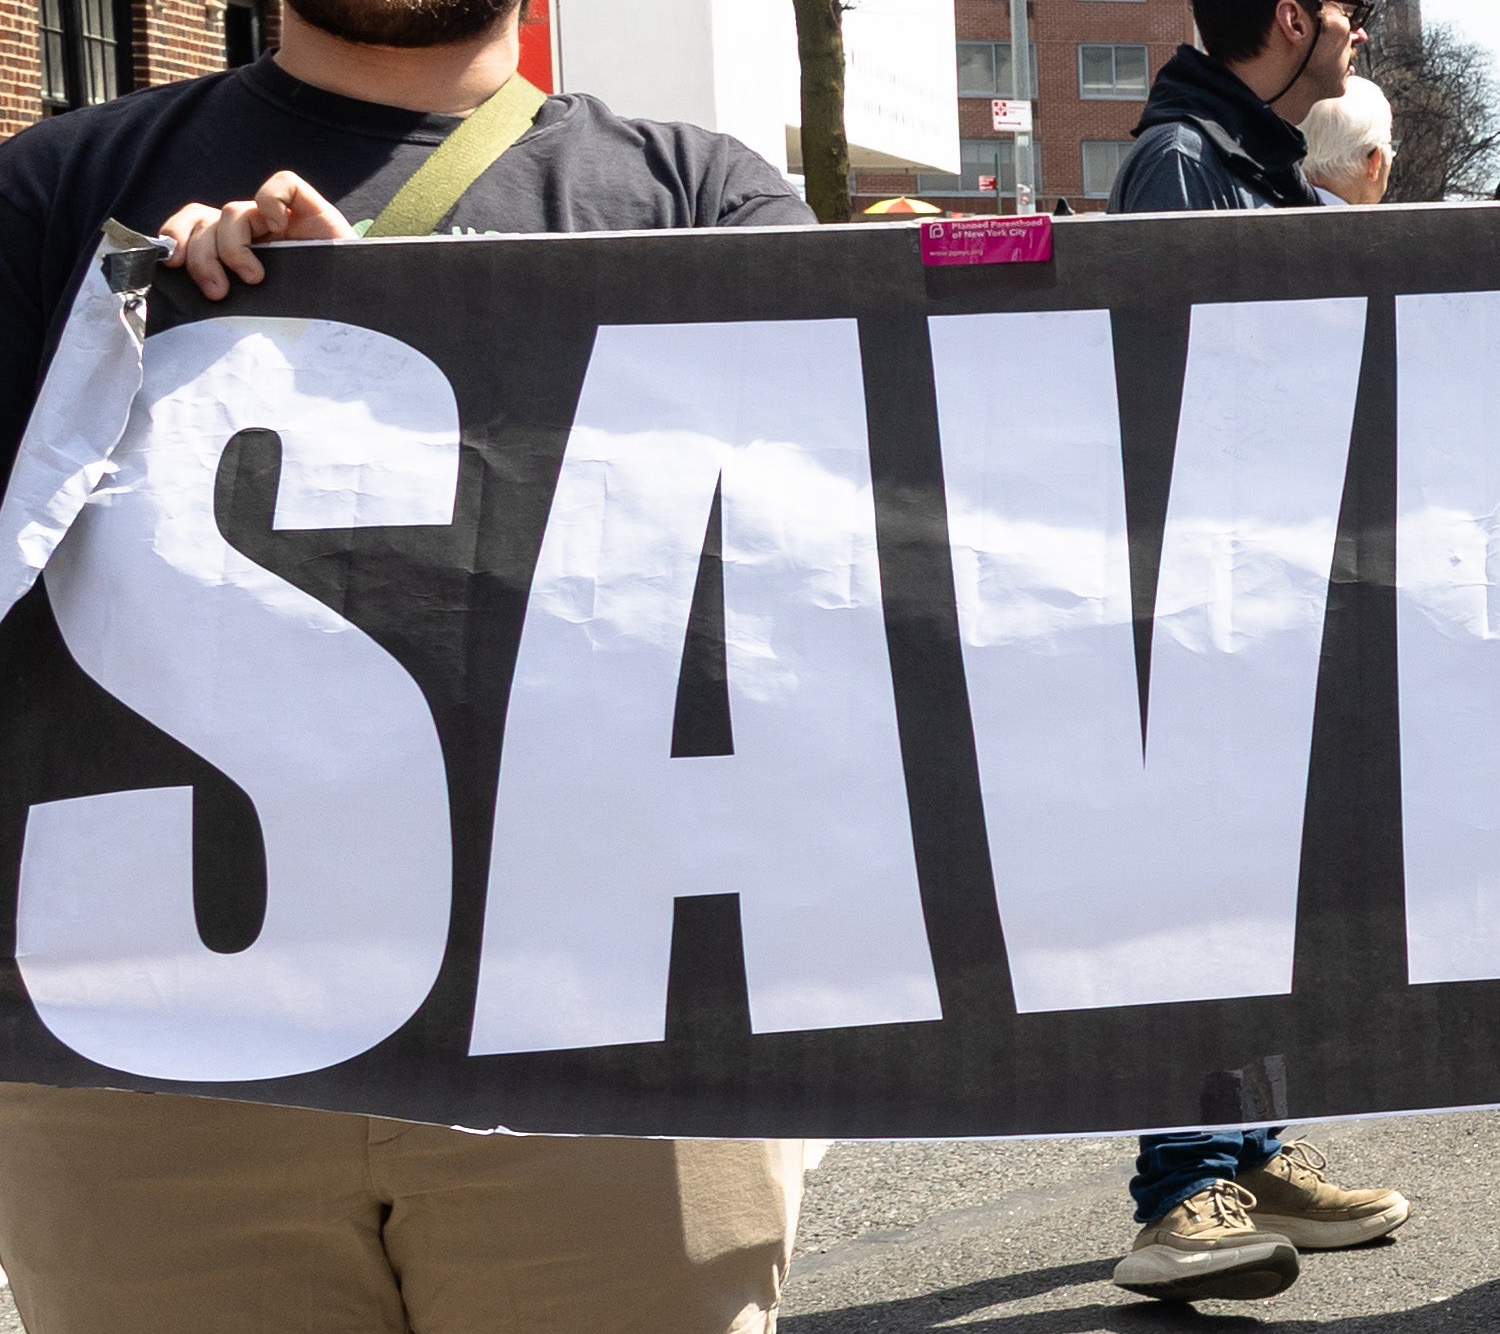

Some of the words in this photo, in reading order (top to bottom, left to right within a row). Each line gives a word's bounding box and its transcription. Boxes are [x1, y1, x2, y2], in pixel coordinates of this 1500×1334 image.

[951, 220, 989, 231] Planned
[990, 218, 1043, 229] Parenthood
[964, 229, 985, 238] New
[985, 228, 1006, 238] York
[1008, 227, 1028, 238] City
